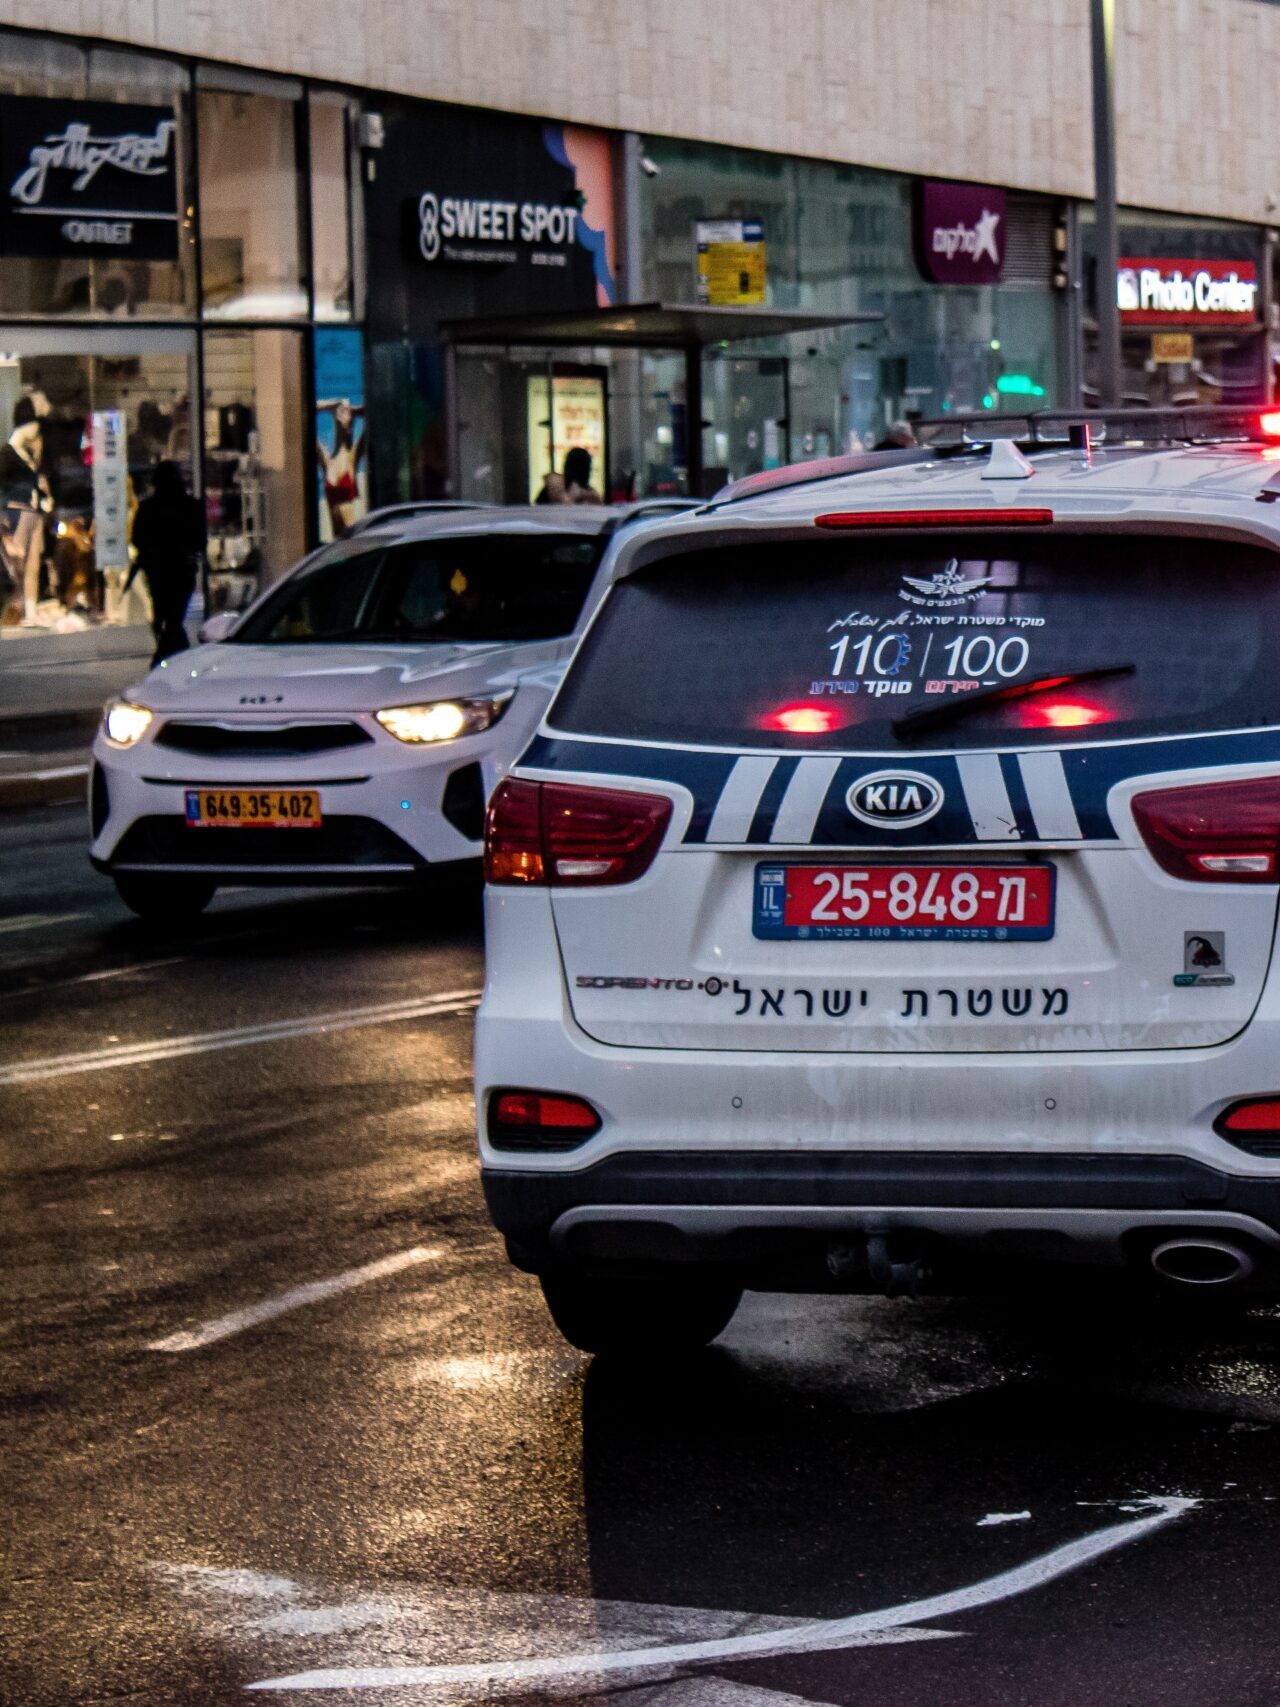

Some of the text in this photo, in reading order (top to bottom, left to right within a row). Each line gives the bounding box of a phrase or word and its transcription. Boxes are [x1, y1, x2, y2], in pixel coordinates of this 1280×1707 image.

[441, 199, 577, 244] SWEET SPOT
[1140, 269, 1257, 312] Photo Center
[958, 614, 1006, 626] משטרת
[1009, 614, 1045, 627] מוקדי
[829, 633, 1030, 678] 110 100
[863, 680, 912, 698] מוקד
[865, 785, 923, 811] KIA
[762, 886, 780, 911] IL
[868, 927, 891, 938] 100
[899, 926, 938, 938] ישראל
[945, 928, 989, 938] משטרת
[576, 976, 694, 991] SORENTO
[733, 979, 1069, 1018] משטרת ישראל
